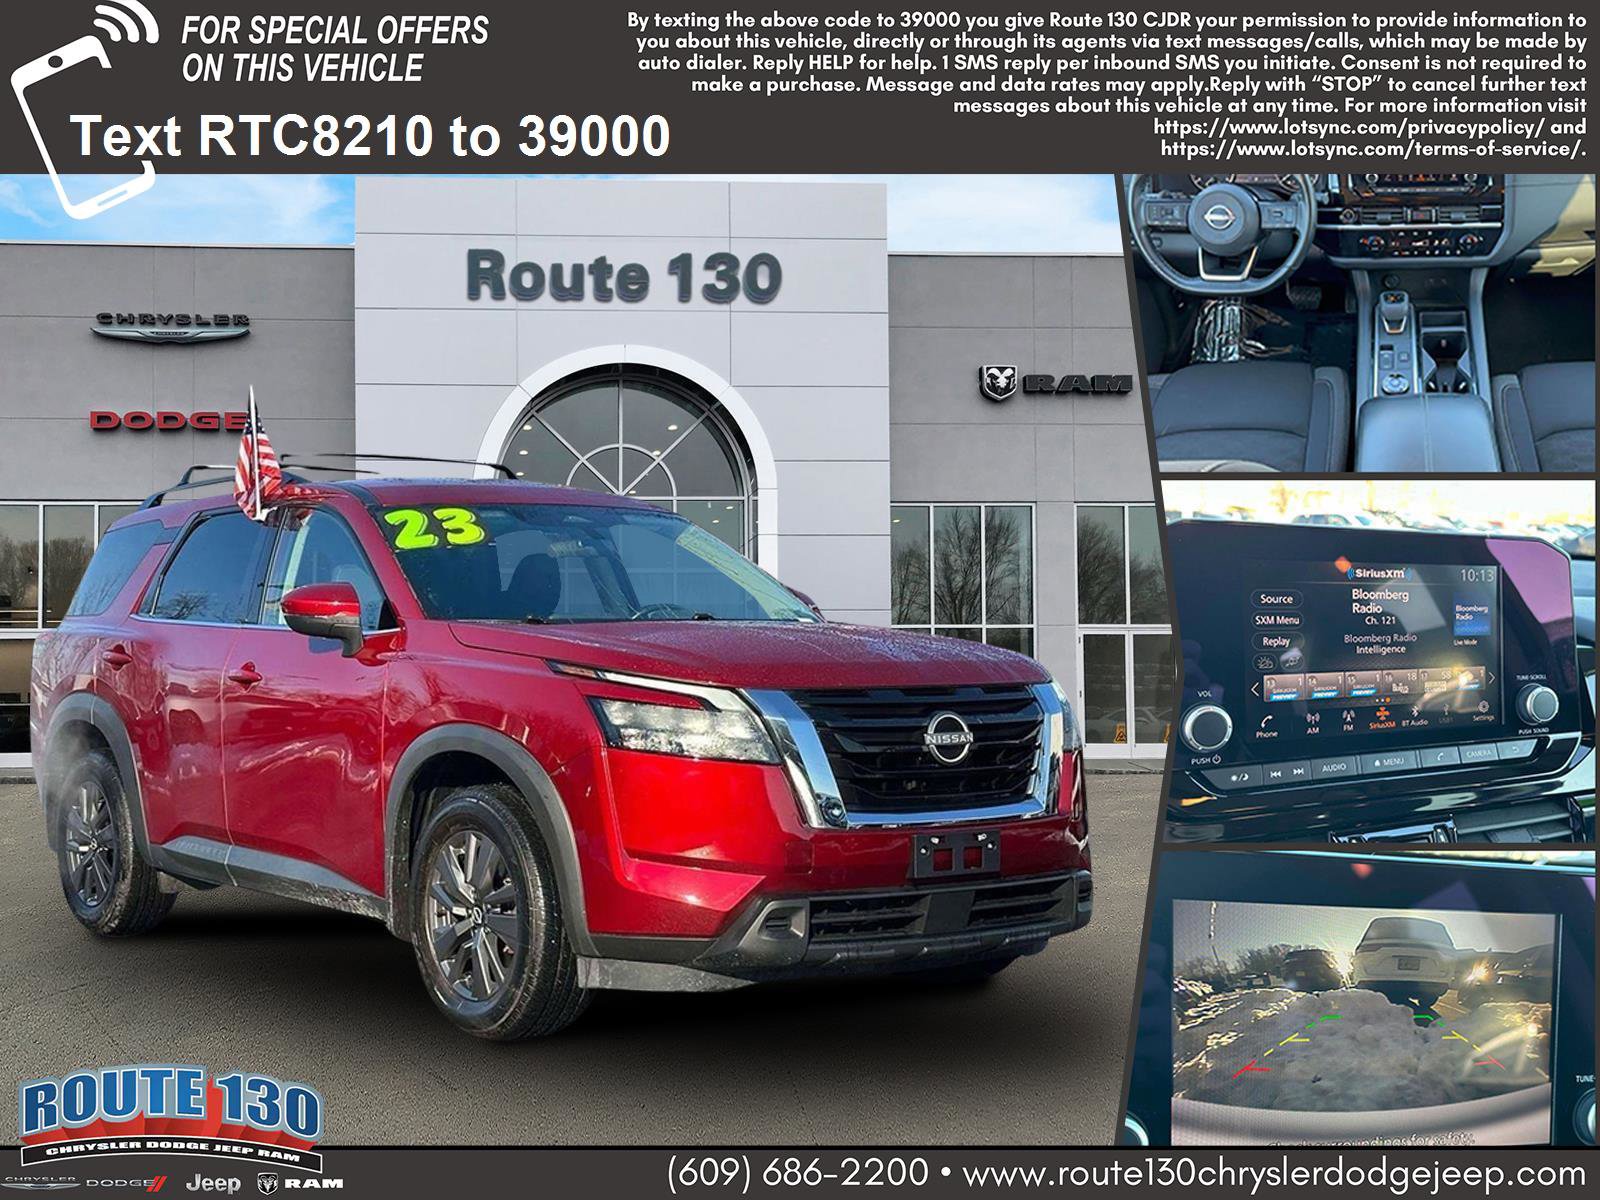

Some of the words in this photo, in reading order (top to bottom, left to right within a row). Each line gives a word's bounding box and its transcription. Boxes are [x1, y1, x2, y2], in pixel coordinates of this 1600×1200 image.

[467, 249, 649, 302] Route
[668, 252, 782, 303] 130
[96, 312, 250, 326] CHRYSLER
[1023, 374, 1133, 394] RAM
[90, 411, 249, 429] DODGE
[384, 507, 485, 549] 23
[1460, 569, 1494, 583] 10:13
[1260, 594, 1293, 604] Source
[1352, 588, 1409, 602] Bloomberg
[1352, 603, 1383, 614] Radio
[1255, 616, 1274, 625] SXM
[1276, 616, 1300, 625] Menu
[1365, 616, 1379, 625] Ch.
[1381, 616, 1396, 625] 121
[1262, 637, 1291, 648] Replay
[1344, 633, 1391, 644] Bloomberg
[1393, 633, 1417, 642] Radio
[1356, 645, 1406, 655] Intelligence
[1198, 690, 1211, 698] VOL
[925, 733, 973, 744] NISSAN
[1256, 730, 1278, 738] Phone
[1191, 756, 1211, 765] PUSH
[1383, 758, 1404, 766] MENU
[1322, 763, 1347, 772] AUDIO
